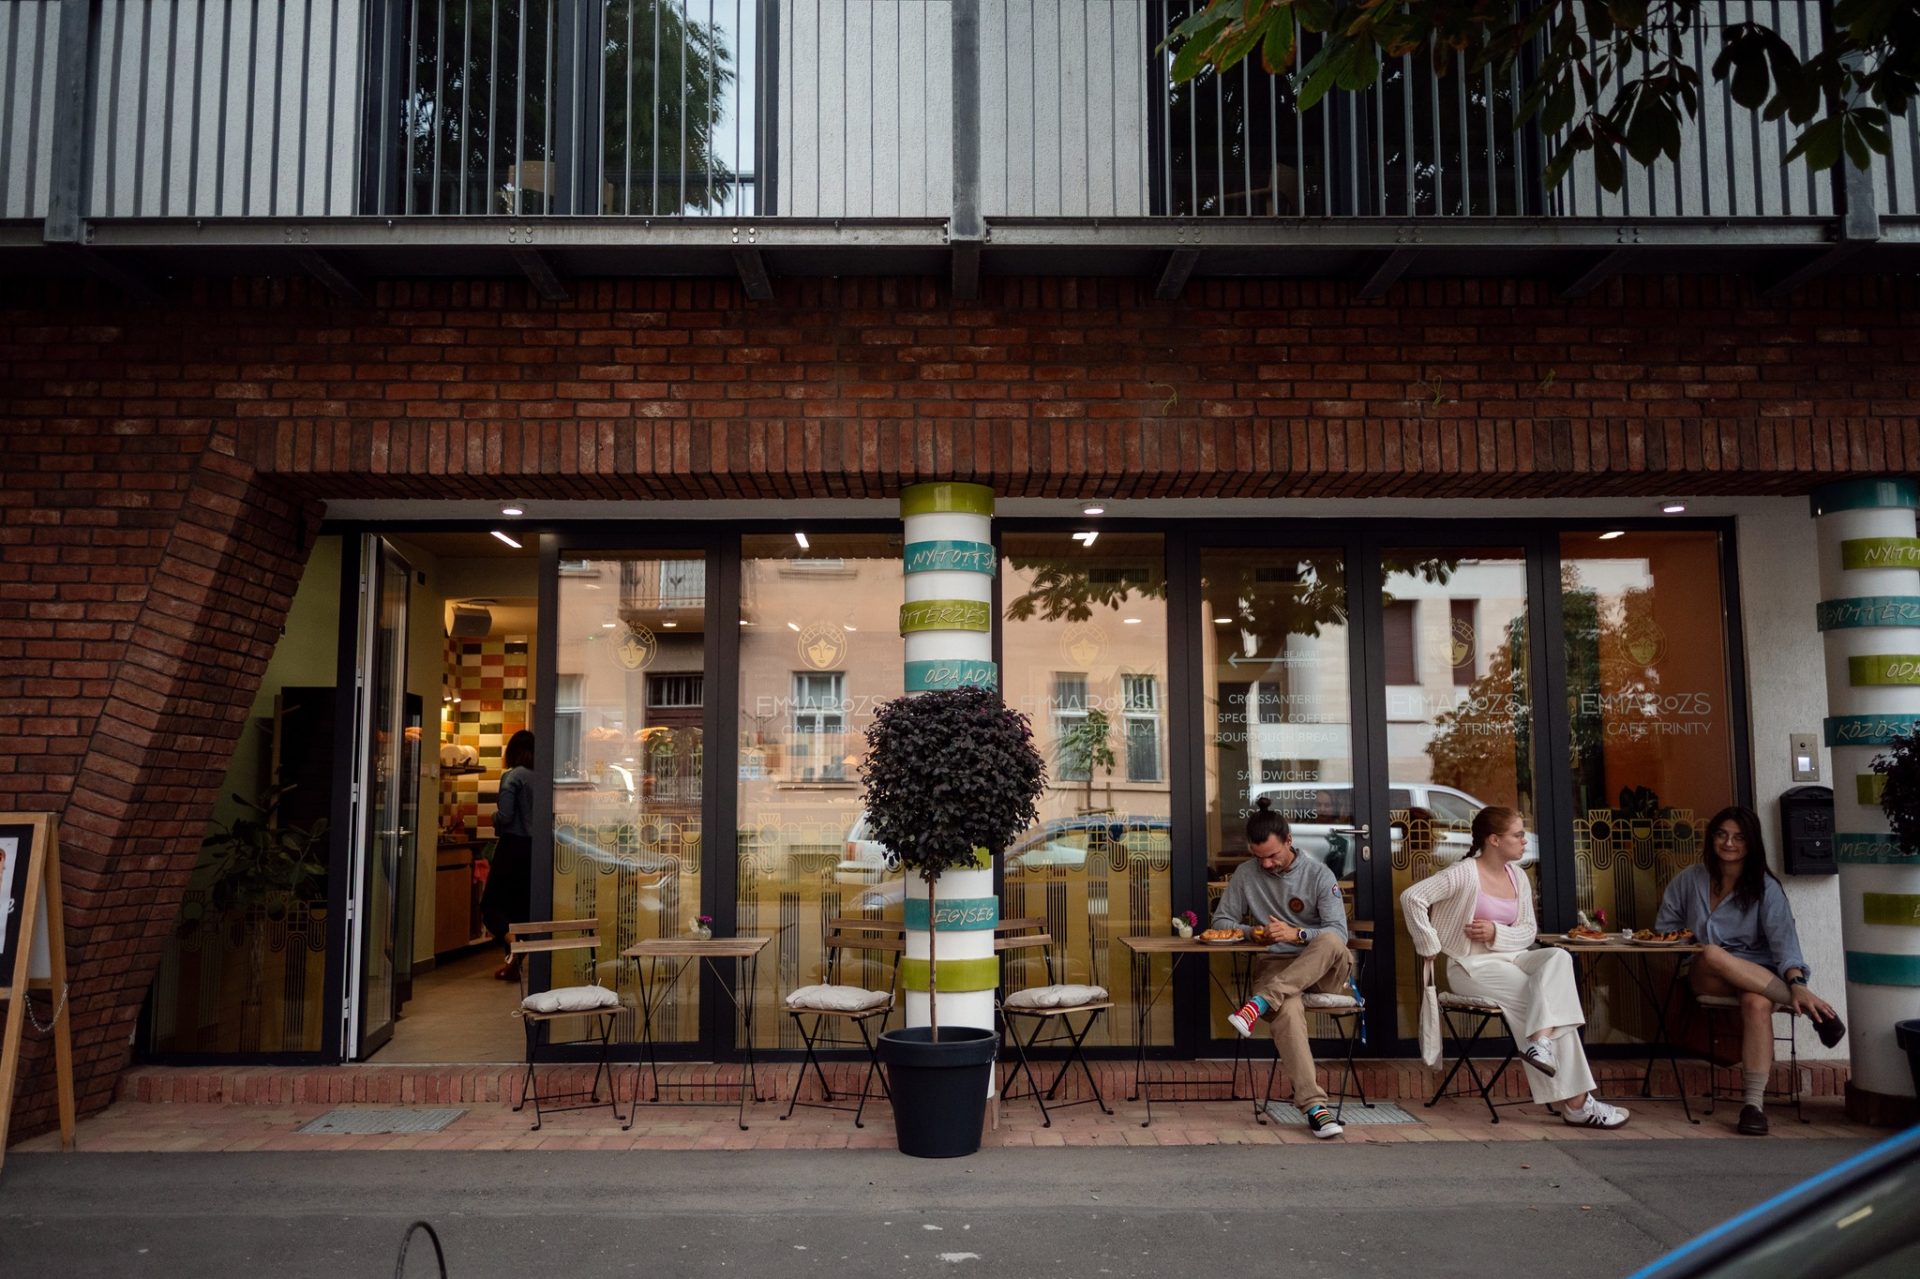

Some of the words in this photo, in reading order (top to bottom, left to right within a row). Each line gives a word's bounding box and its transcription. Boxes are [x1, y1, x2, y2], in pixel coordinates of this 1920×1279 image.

[1228, 694, 1323, 704] CROSSANTERIE
[1218, 713, 1285, 723] SPECALITY
[1288, 713, 1336, 723] COFFEE
[827, 725, 867, 736] TRINI
[1650, 722, 1712, 735] TRINITY
[1215, 732, 1295, 743] SOURDOUGH
[1298, 732, 1338, 743] BREAD
[1256, 751, 1300, 760] PASTRY
[1236, 770, 1319, 780] SANDWICHES
[1276, 789, 1318, 800] JUICES
